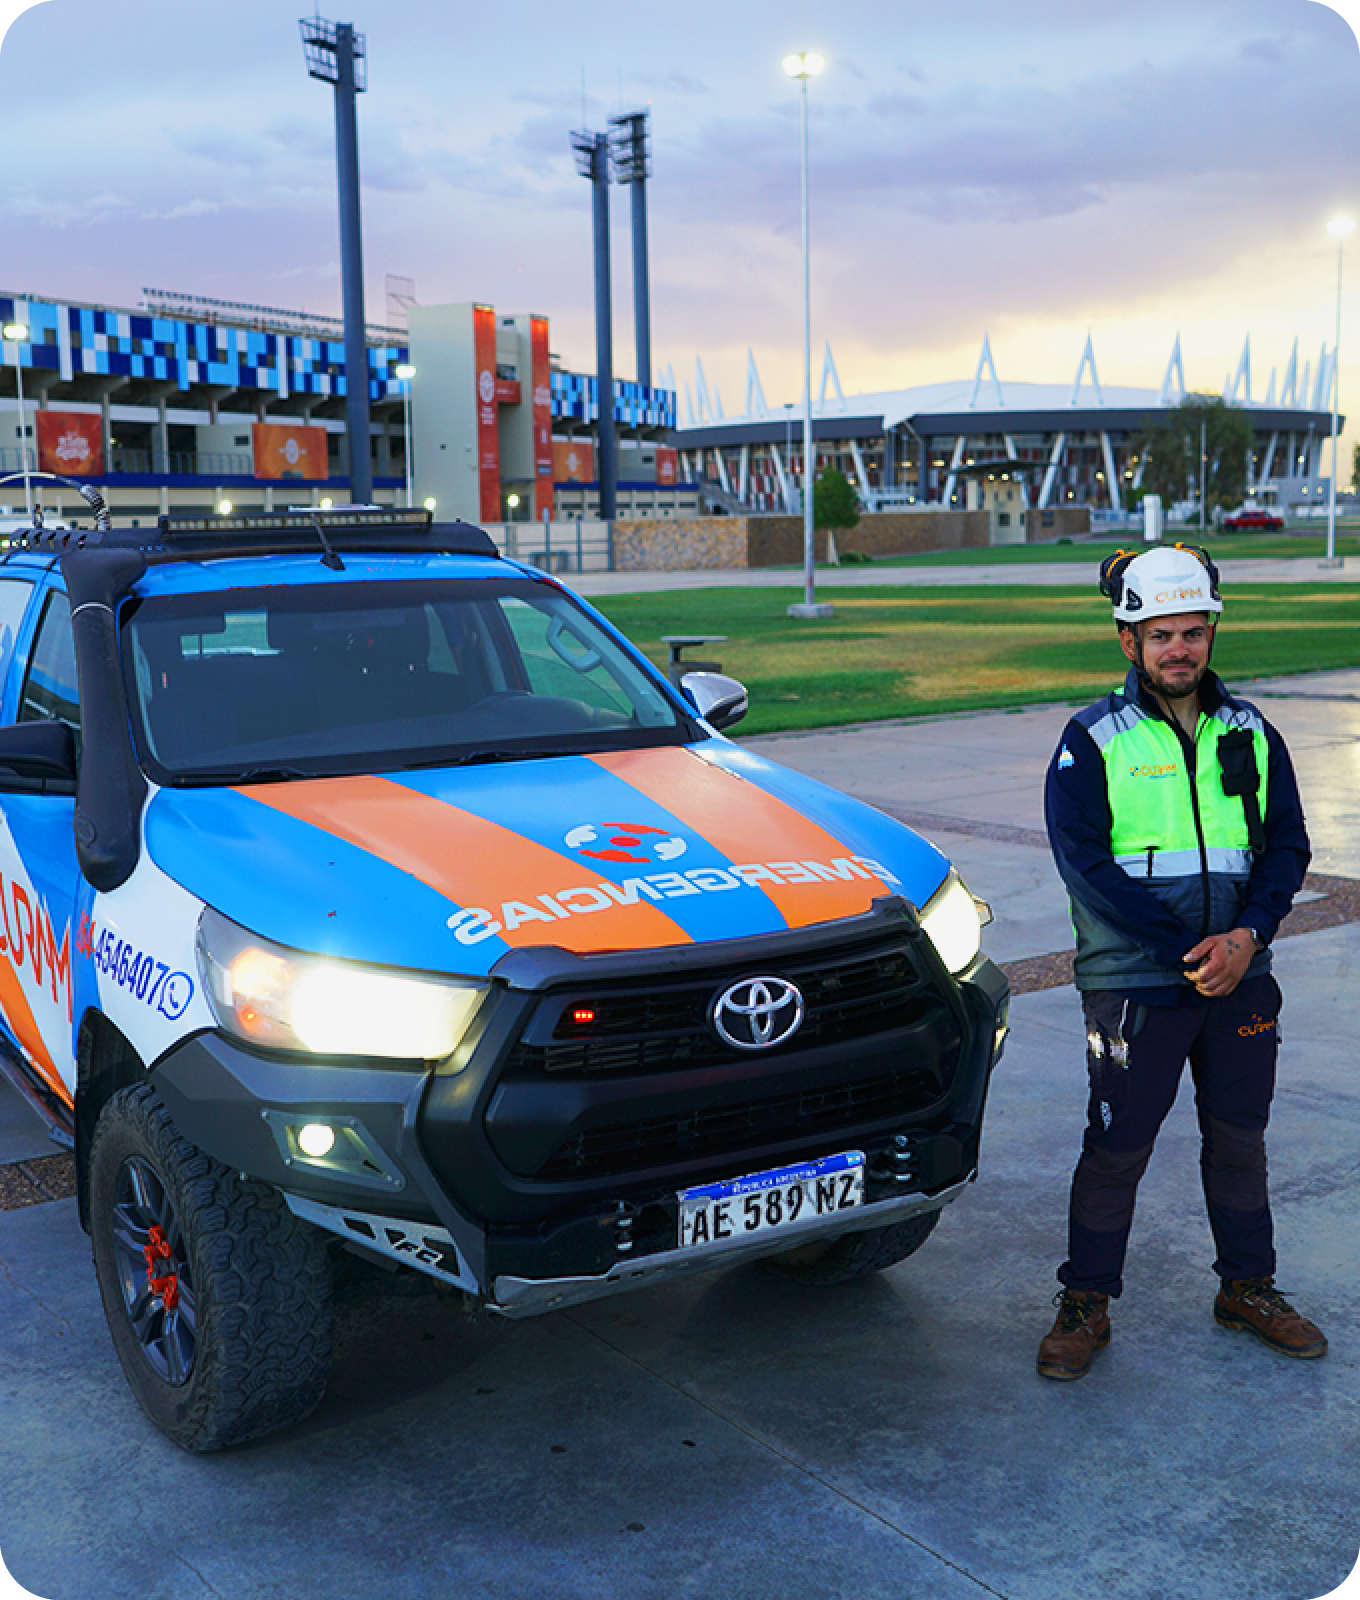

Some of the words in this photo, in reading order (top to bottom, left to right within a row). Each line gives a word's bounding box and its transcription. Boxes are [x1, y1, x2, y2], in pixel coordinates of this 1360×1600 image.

[96, 927, 171, 1006] 4546407
[692, 1202, 732, 1245] AE
[744, 1184, 803, 1231] 589
[815, 1173, 856, 1215] NZ
